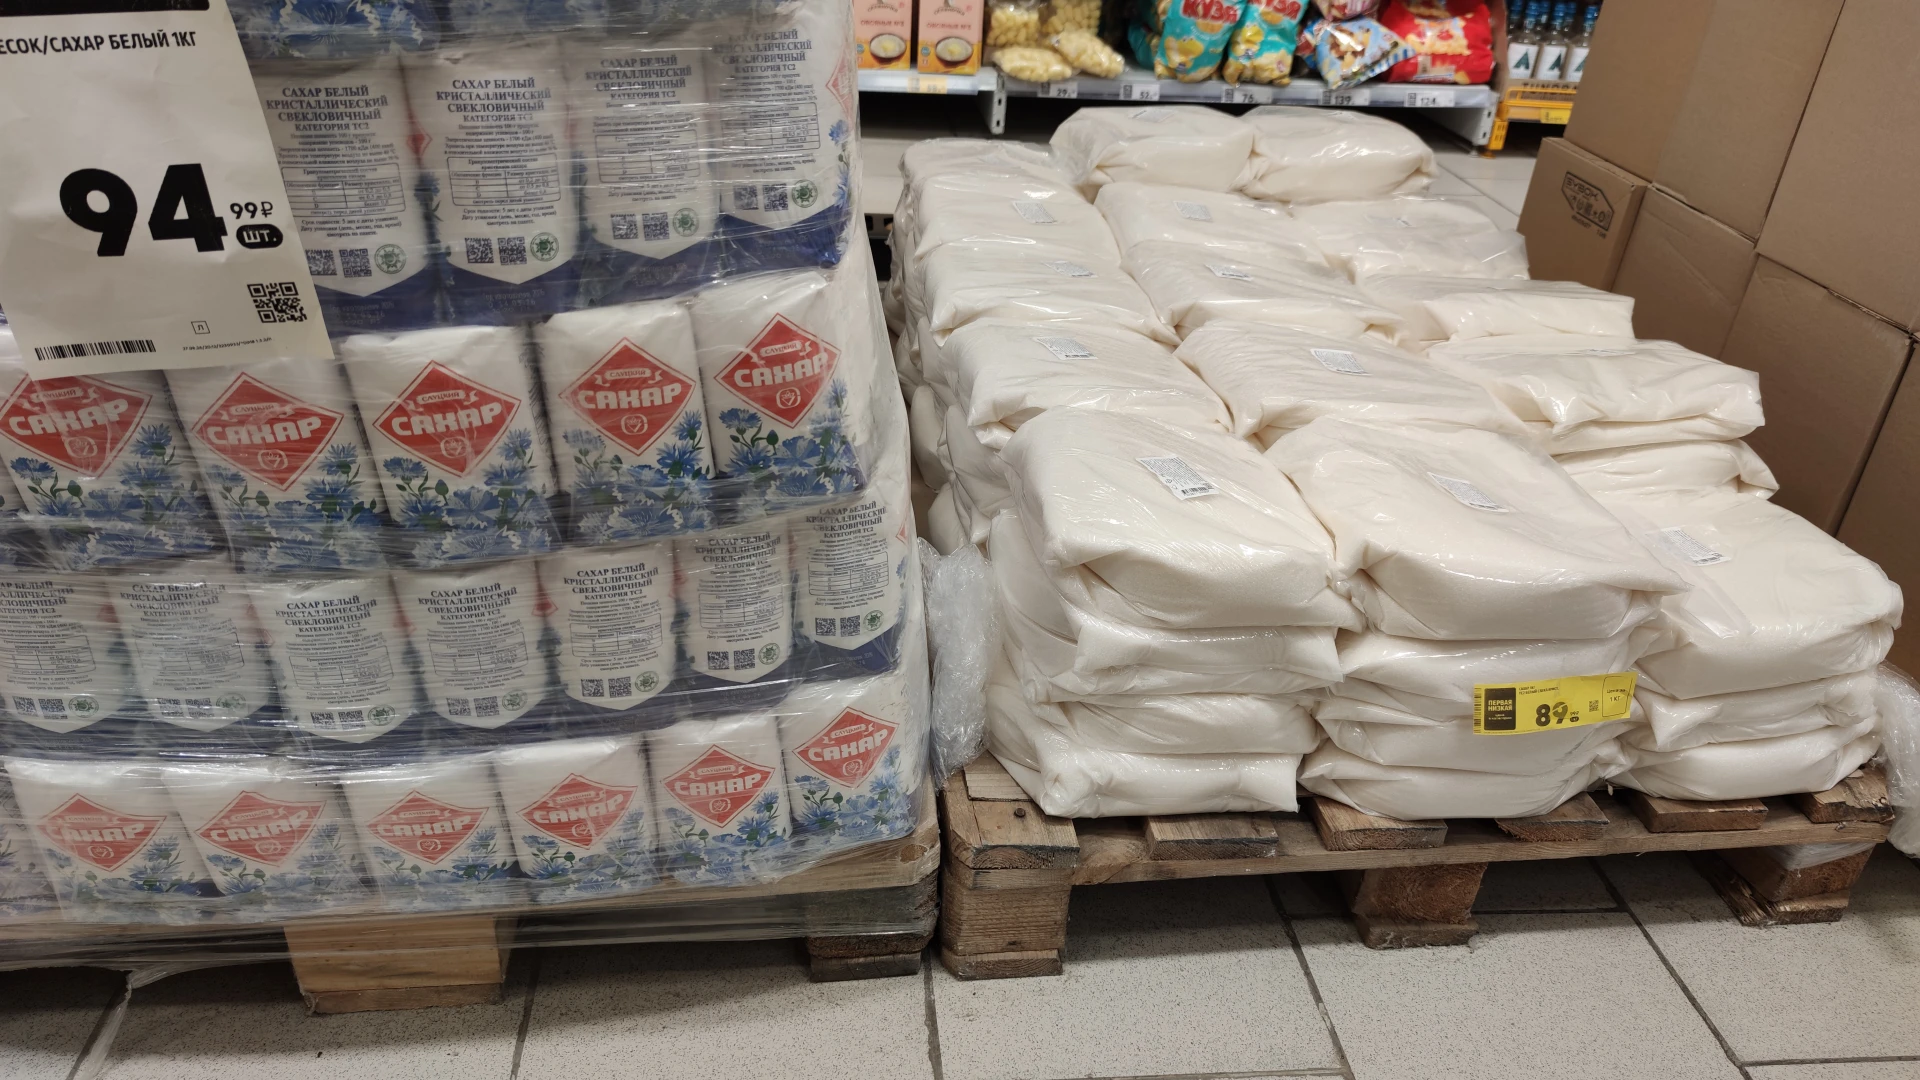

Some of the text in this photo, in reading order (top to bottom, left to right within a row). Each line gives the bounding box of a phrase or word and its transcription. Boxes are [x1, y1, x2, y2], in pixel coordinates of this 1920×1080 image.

[110, 29, 170, 50] БЕЛЫЙ
[171, 31, 197, 48] 1КГ
[764, 29, 798, 40] БЕЛЫЙ
[585, 65, 692, 80] КРИСТАЛЛИЧЕСКИЙ
[452, 77, 535, 89] САХАР БЕЛЫЙ
[282, 84, 369, 98] САХАР БЕЛЫЙ
[436, 88, 551, 101] КРИСТАЛЛИЧЕСКИЙ
[662, 90, 676, 98] ТС2
[266, 95, 388, 110] КРИСТАЛЛИЧЕСКИЙ
[448, 101, 544, 113] СВЕКЛОВИЧНЫЙ
[278, 108, 382, 122] СВЕКЛОВИЧНЫЙ
[295, 123, 350, 132] КАТЕГОРИЯ
[59, 163, 228, 257] 94
[242, 230, 278, 244] ШТ.
[609, 368, 646, 378] СЛУЦКИЙ
[733, 351, 829, 388] САХАР
[421, 391, 461, 402] СЛУЦКИЙ
[576, 382, 682, 410] САХАР
[8, 398, 129, 436] САХАР
[391, 402, 503, 436] САХАР
[207, 416, 321, 445] САХАР
[813, 516, 882, 531] СВЕКЛОВИЧНЫЙ
[824, 529, 861, 538] КАТЕГОРИЯ
[564, 567, 659, 586] КРИСТАЛЛИЧЕСКИЙ
[577, 562, 646, 577] САХАР БЕЛЫЙ
[132, 584, 165, 593] САХАР
[431, 582, 501, 598] САХАР БЕЛЫЙ
[572, 578, 653, 594] СВЕКЛОВИЧНЫЙ
[286, 595, 360, 610] САХАР БЕЛЫЙ
[418, 586, 518, 606] КРИСТАЛЛИЧЕСКИЙ
[585, 592, 628, 600] КАТЕГОРИЯ
[275, 598, 377, 618] КРИСТАЛЛИЧЕСКИЙ
[427, 597, 511, 614] СВЕКЛОВИЧНЫЙ
[285, 610, 371, 626] СВЕКЛОВИЧНЫЙ
[440, 608, 501, 620] КАТЕГОРИЯ ТС2
[299, 621, 361, 633] КАТЕГОРИЯ ТС2
[1535, 701, 1569, 727] 89
[834, 725, 863, 737] СЛУЦКИЙ
[807, 728, 888, 762] САХАР
[700, 766, 732, 774] СЛУЦКИЙ
[674, 772, 762, 796] САХАР
[532, 794, 624, 824] САХАР
[45, 823, 146, 842] САХАР
[210, 810, 309, 842] САХАР
[375, 815, 472, 837] САХАР
